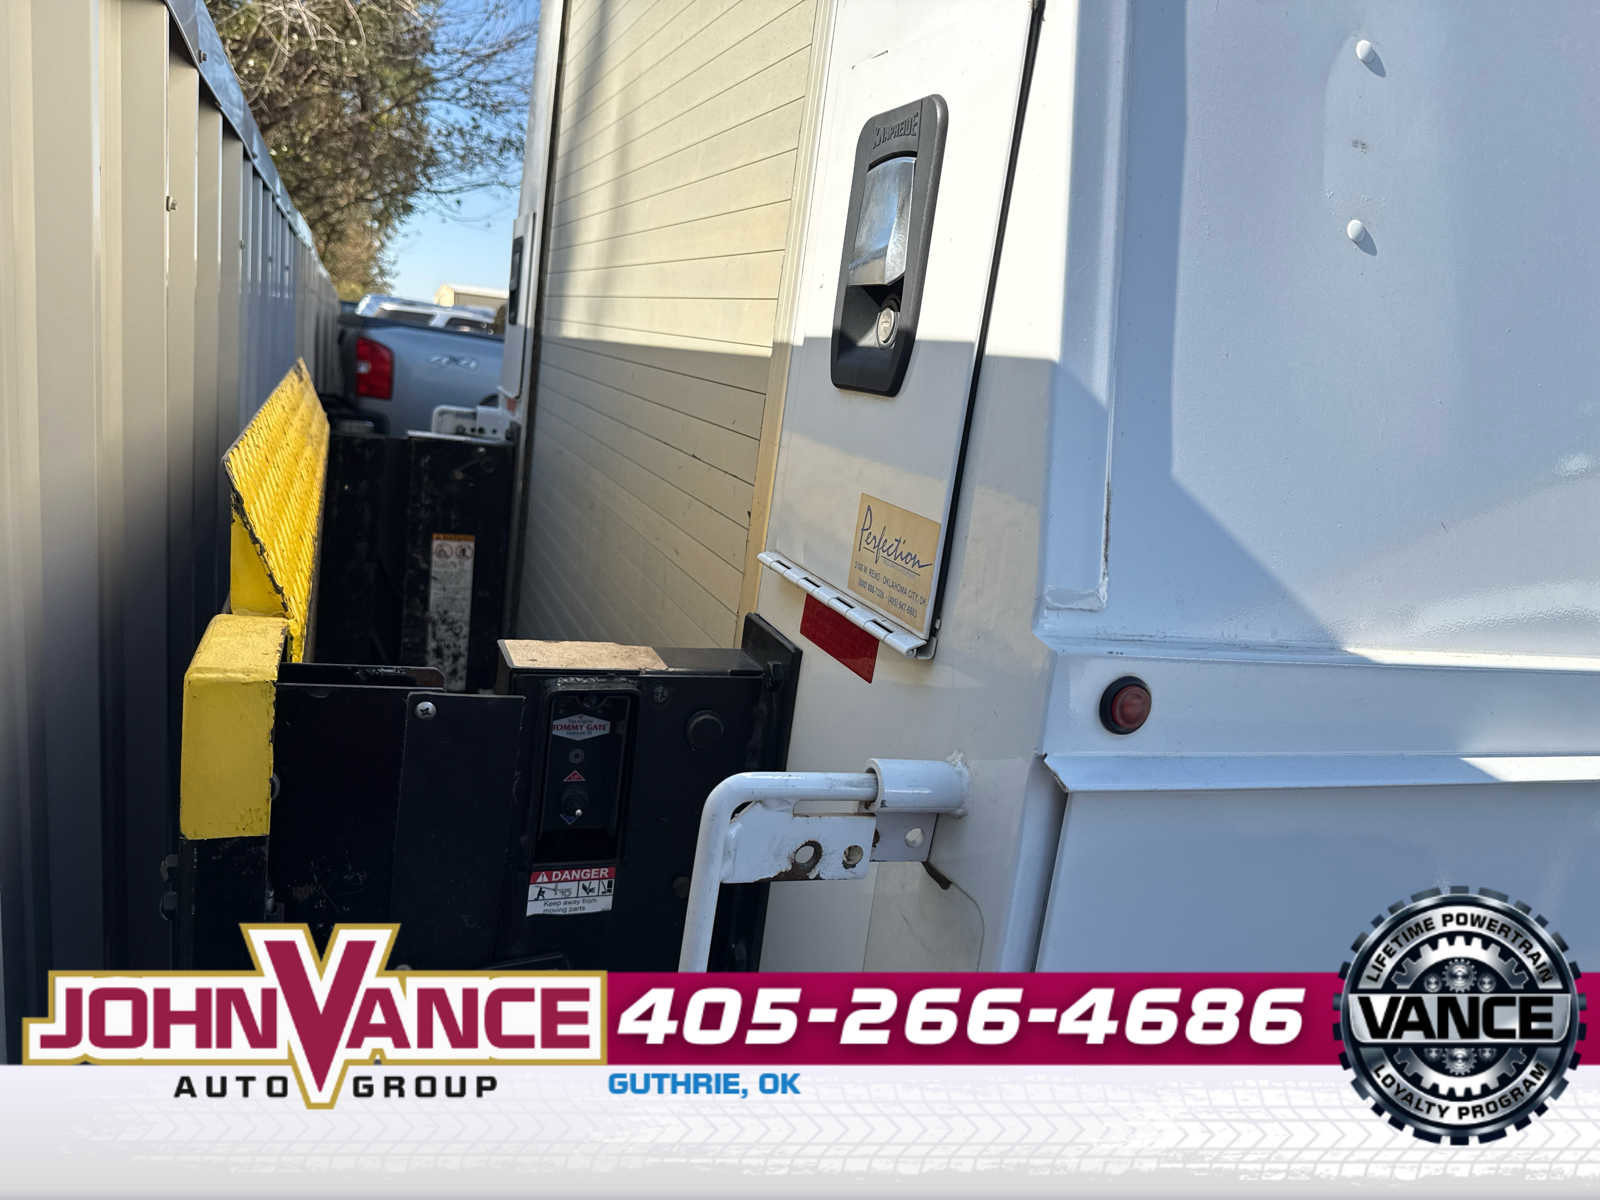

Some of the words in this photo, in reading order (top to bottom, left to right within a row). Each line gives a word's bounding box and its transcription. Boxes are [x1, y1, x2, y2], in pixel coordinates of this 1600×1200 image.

[858, 504, 933, 569] Perfection
[882, 575, 907, 595] OKLAHOMA
[585, 723, 606, 731] GATE
[551, 868, 609, 882] DANGER
[544, 900, 562, 908] Keep
[562, 899, 581, 907] away
[543, 906, 568, 914] moving
[568, 905, 586, 913] parts
